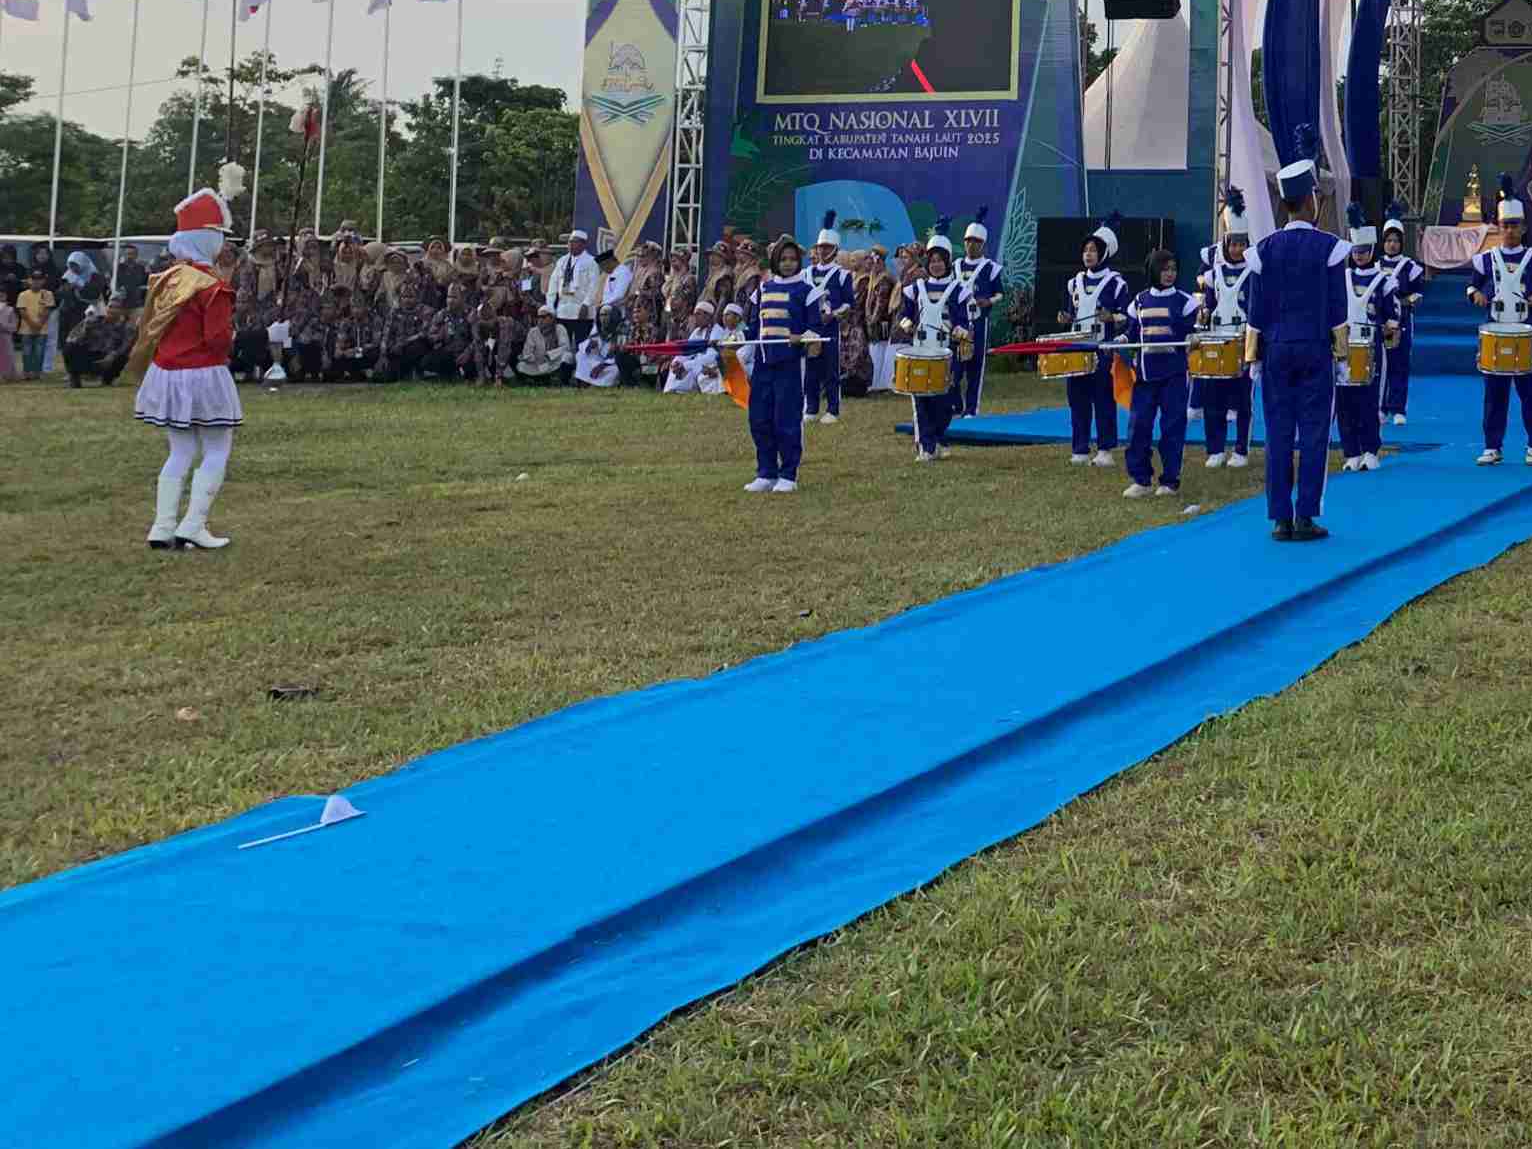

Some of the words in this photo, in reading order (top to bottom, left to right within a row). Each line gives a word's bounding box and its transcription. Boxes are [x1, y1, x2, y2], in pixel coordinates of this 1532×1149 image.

[774, 112, 830, 134] MTQ
[828, 110, 935, 130] NASIONAL
[944, 109, 1001, 129] XLVII
[773, 134, 820, 146] TINGKAT
[824, 132, 887, 145] KABUPATEN
[891, 132, 930, 144] TANAH
[934, 131, 962, 144] LAUT
[967, 132, 1000, 145] 2025
[808, 148, 823, 161] DI
[828, 147, 908, 160] KECAMATAN
[914, 146, 959, 162] BAJUIN
